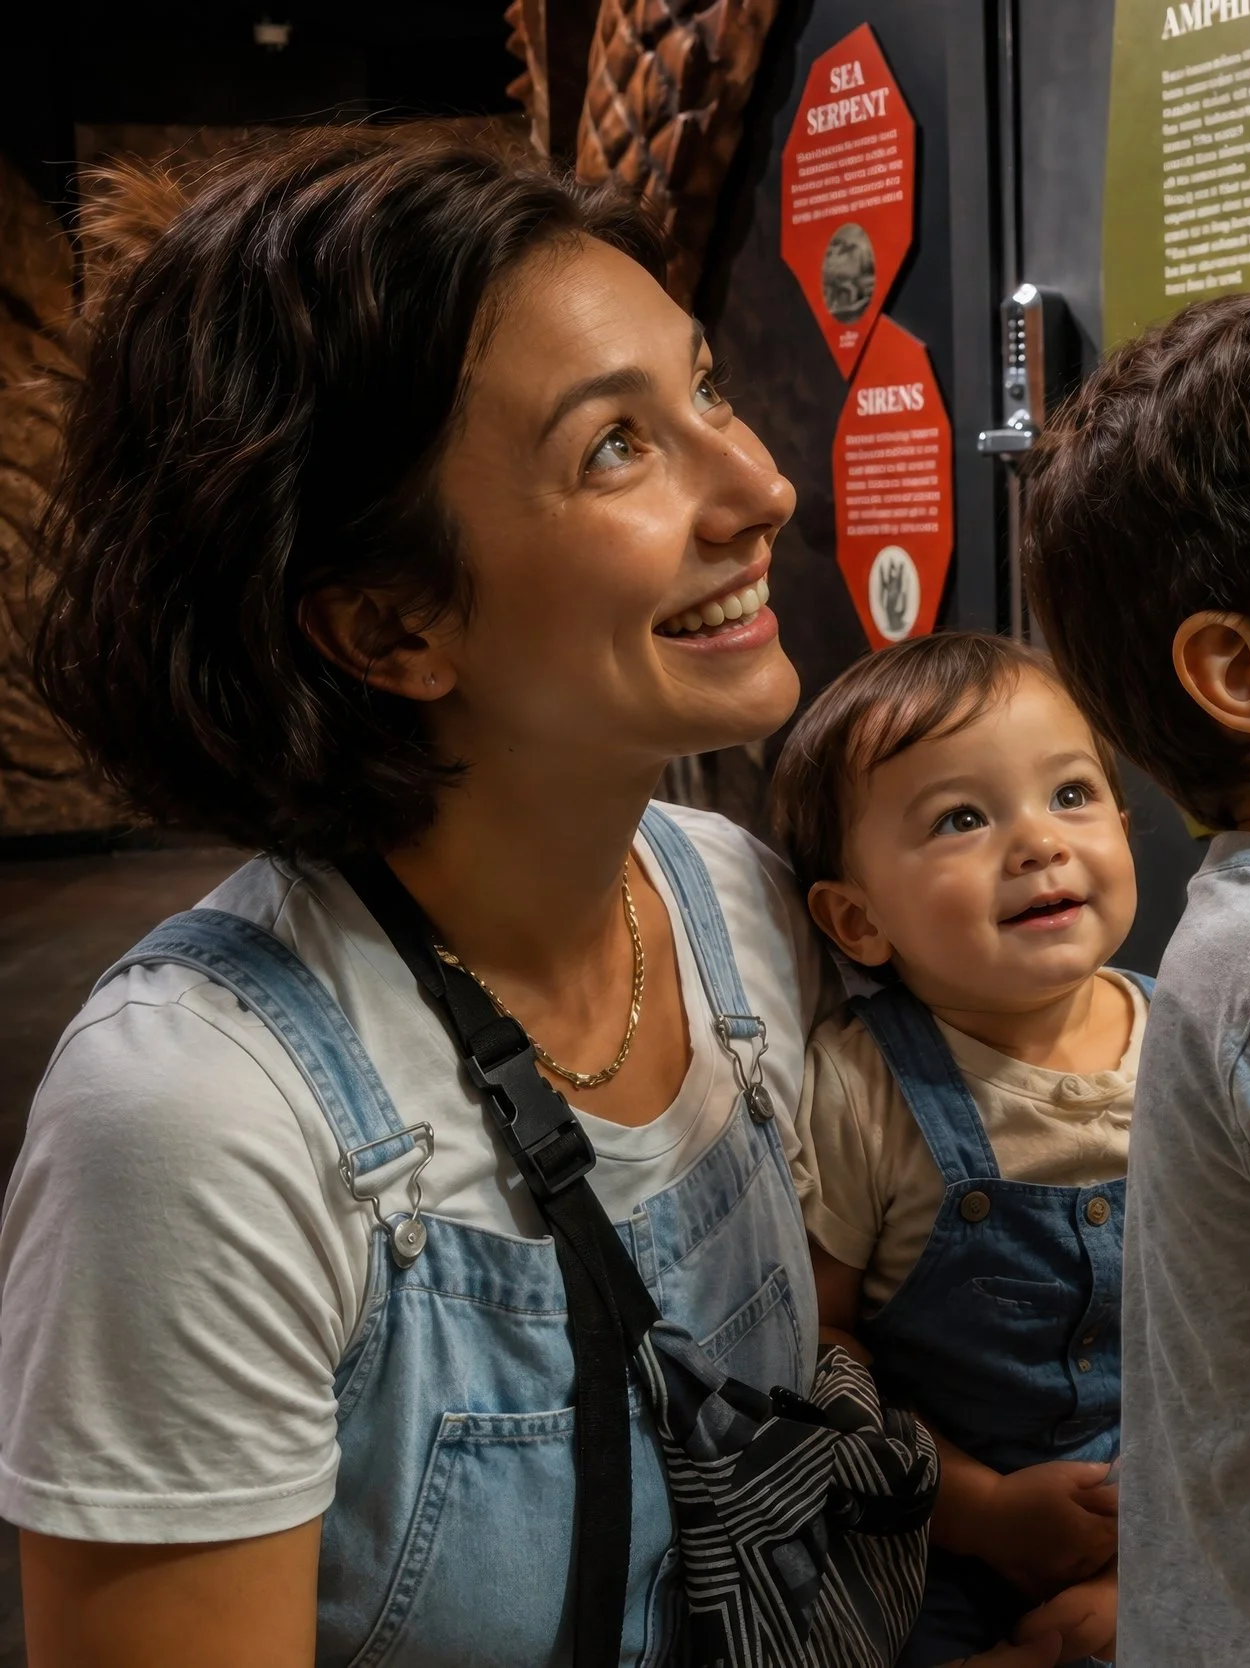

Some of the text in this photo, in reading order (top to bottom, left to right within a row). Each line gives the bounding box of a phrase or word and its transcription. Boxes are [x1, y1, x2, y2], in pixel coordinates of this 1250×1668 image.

[830, 60, 865, 93] SEA
[807, 86, 889, 135] SERPENT
[857, 382, 925, 416] SIRENS
